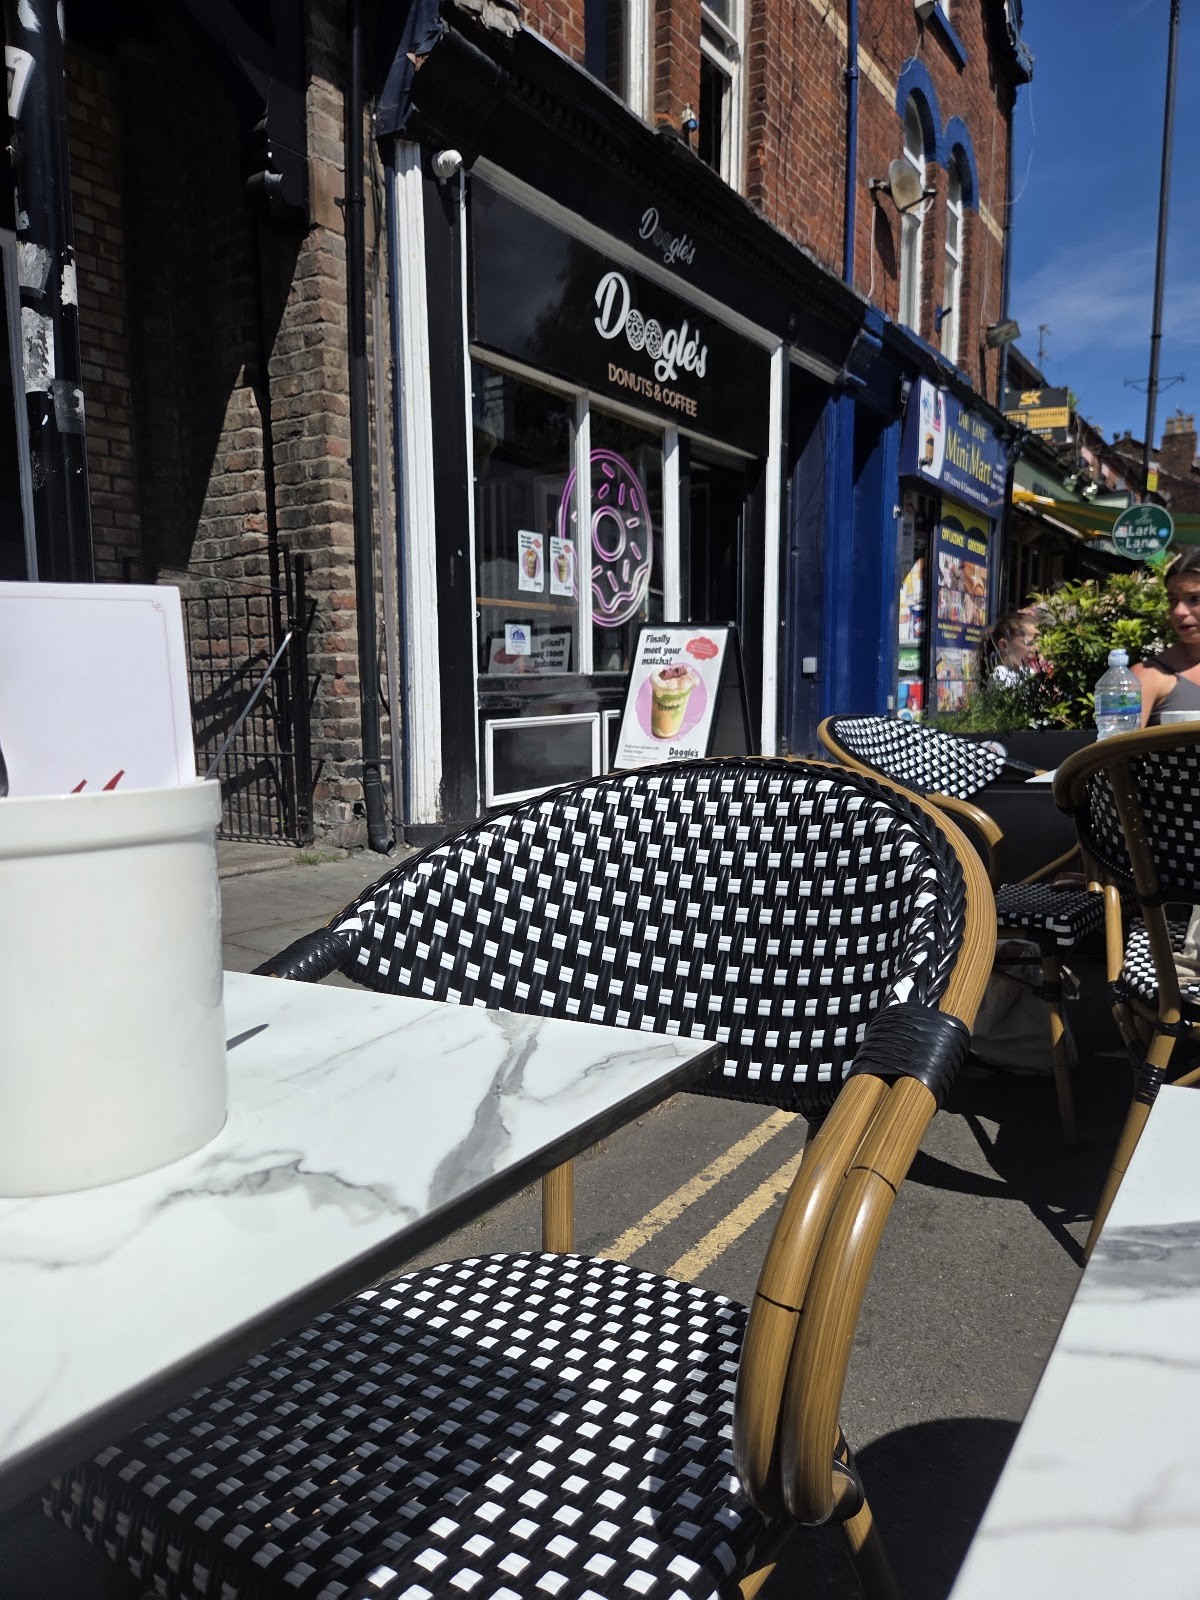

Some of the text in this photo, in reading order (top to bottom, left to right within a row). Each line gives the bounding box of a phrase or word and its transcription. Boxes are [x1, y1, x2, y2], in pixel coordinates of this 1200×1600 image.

[594, 271, 708, 382] Doogle's
[608, 362, 698, 418] DONUTS & COFFEE
[945, 426, 992, 486] Mini Mart
[1128, 524, 1157, 537] Lark
[645, 634, 671, 645] Finally
[663, 647, 682, 656] your
[641, 657, 673, 665] matcha!
[668, 747, 699, 758] Doogle's
